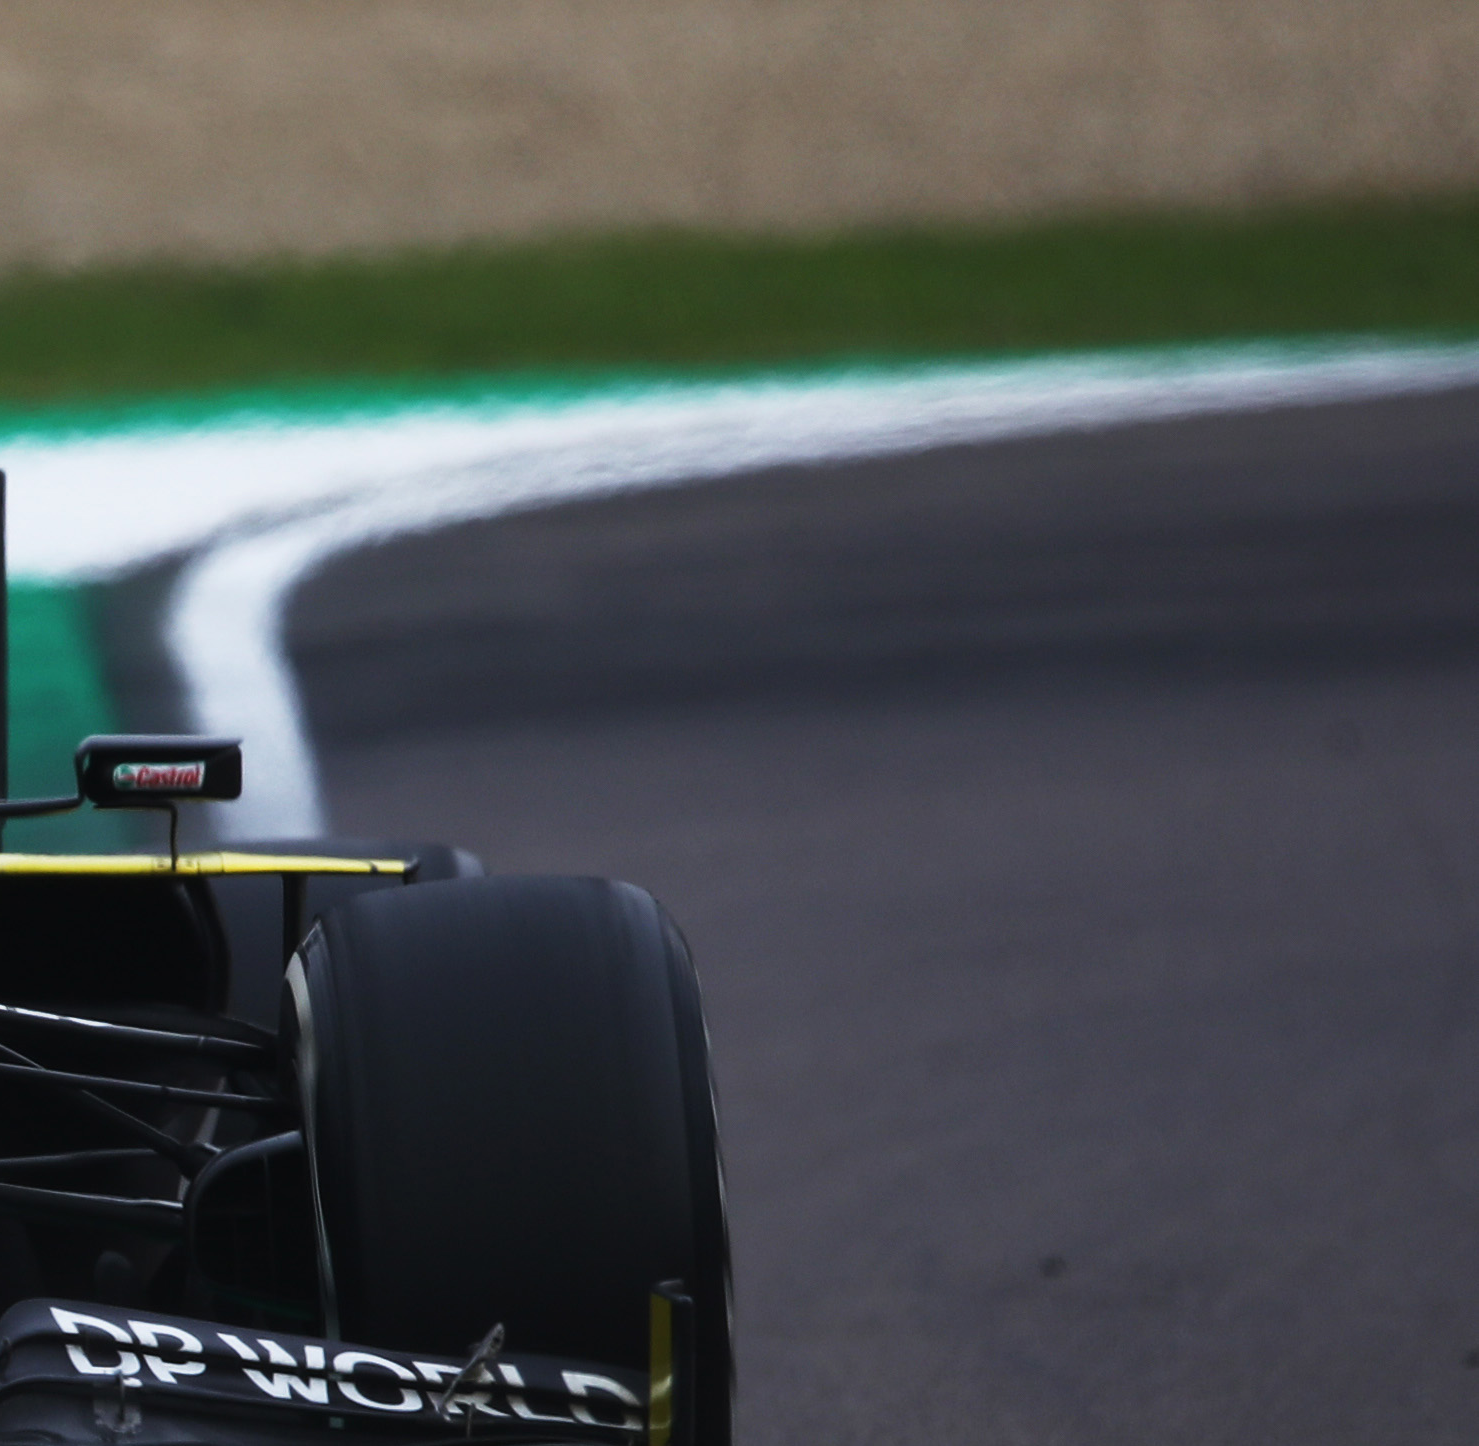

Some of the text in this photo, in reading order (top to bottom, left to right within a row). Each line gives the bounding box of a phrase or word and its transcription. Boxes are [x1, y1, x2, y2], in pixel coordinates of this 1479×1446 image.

[137, 765, 200, 787] Castrol
[49, 1307, 644, 1431] DP WORLD
